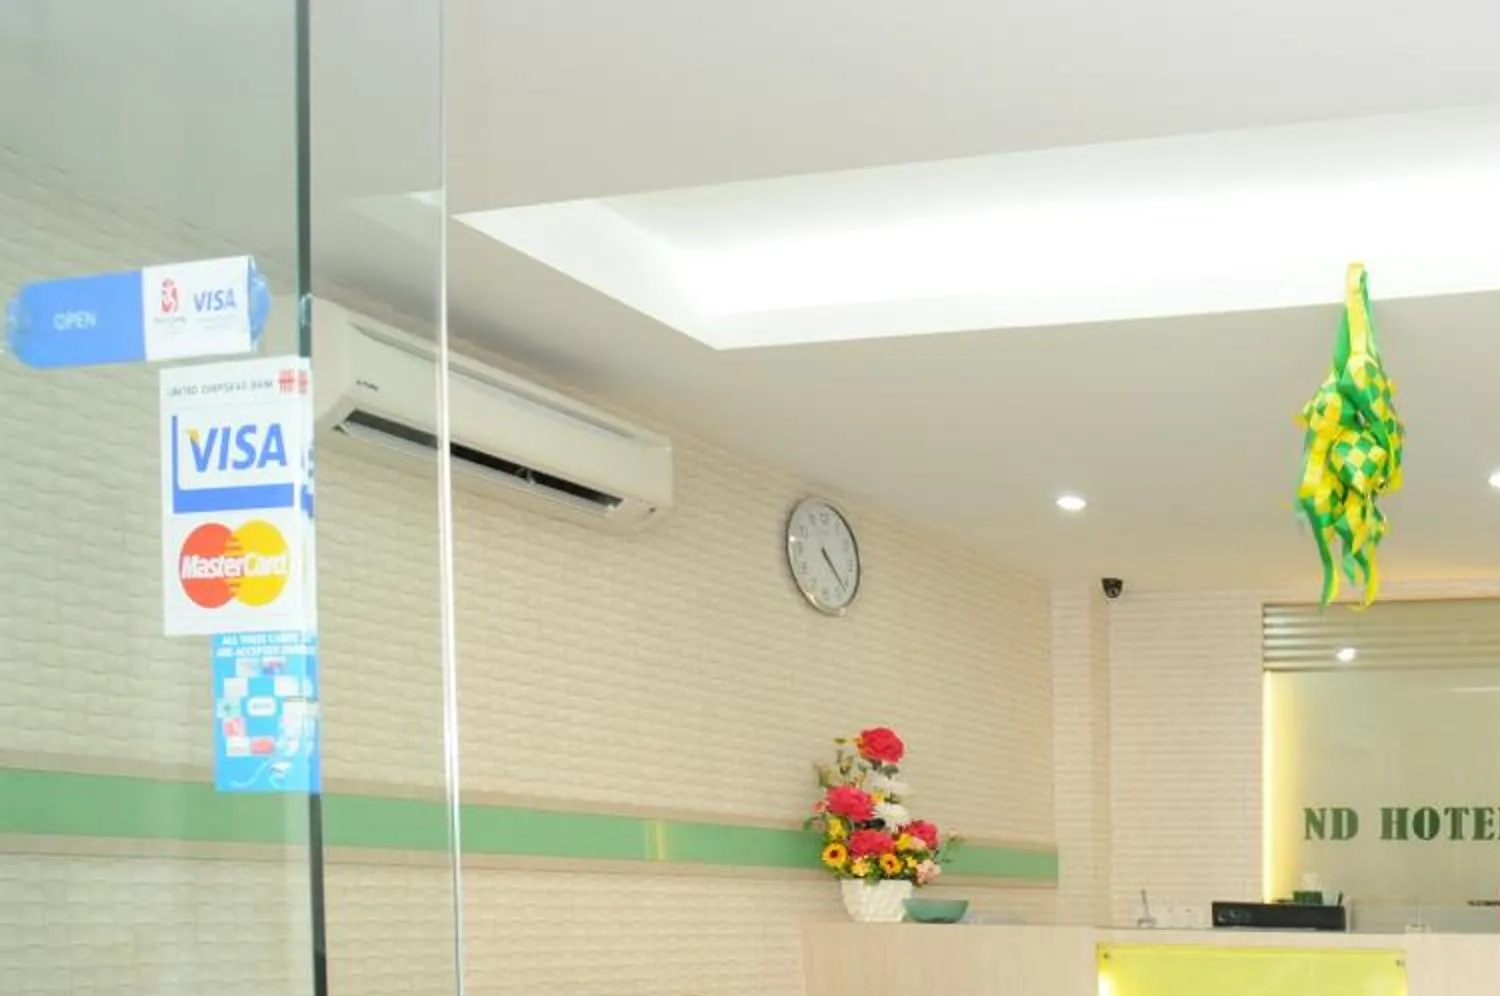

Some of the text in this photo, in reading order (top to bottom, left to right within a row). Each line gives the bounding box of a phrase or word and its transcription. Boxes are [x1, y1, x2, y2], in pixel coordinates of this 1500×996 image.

[193, 288, 237, 313] VISA
[186, 422, 289, 473] VISA
[181, 553, 289, 580] MasterCard
[1303, 806, 1360, 841] ND
